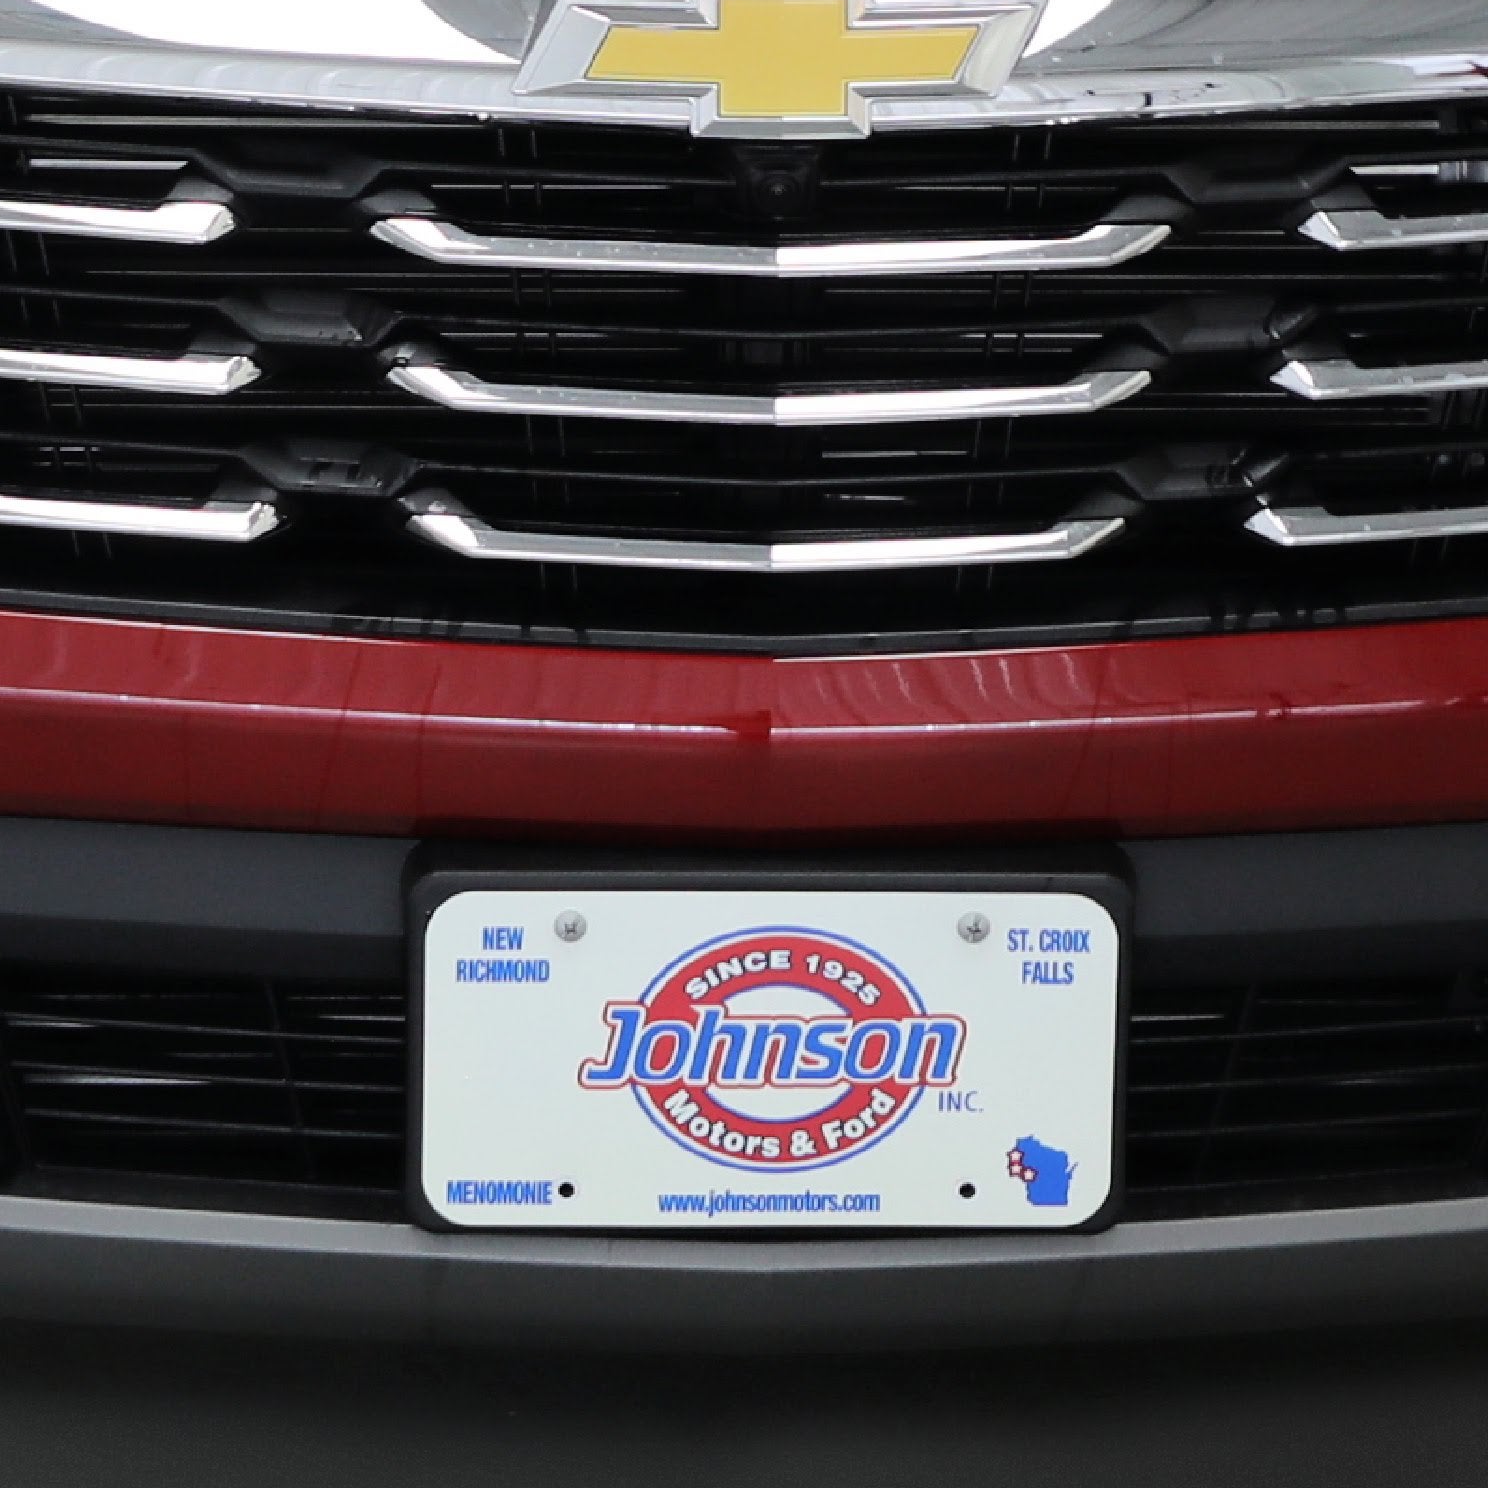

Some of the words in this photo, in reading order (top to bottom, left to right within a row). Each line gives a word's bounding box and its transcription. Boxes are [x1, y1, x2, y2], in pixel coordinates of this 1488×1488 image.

[481, 925, 524, 950] NEW
[1007, 929, 1033, 952] ST.
[1039, 929, 1091, 952] CROIX
[456, 959, 550, 983] RICHMOND
[684, 949, 792, 1000] SINCE
[1022, 961, 1074, 985] FALLS
[584, 1007, 960, 1082] Johnson
[937, 1090, 984, 1113] INC.
[663, 1088, 782, 1158] Motors
[788, 1128, 819, 1157] &
[821, 1087, 897, 1150] Ford
[447, 1179, 553, 1205] MENOMONIE
[658, 1189, 881, 1218] www.johnsonmotors.com
